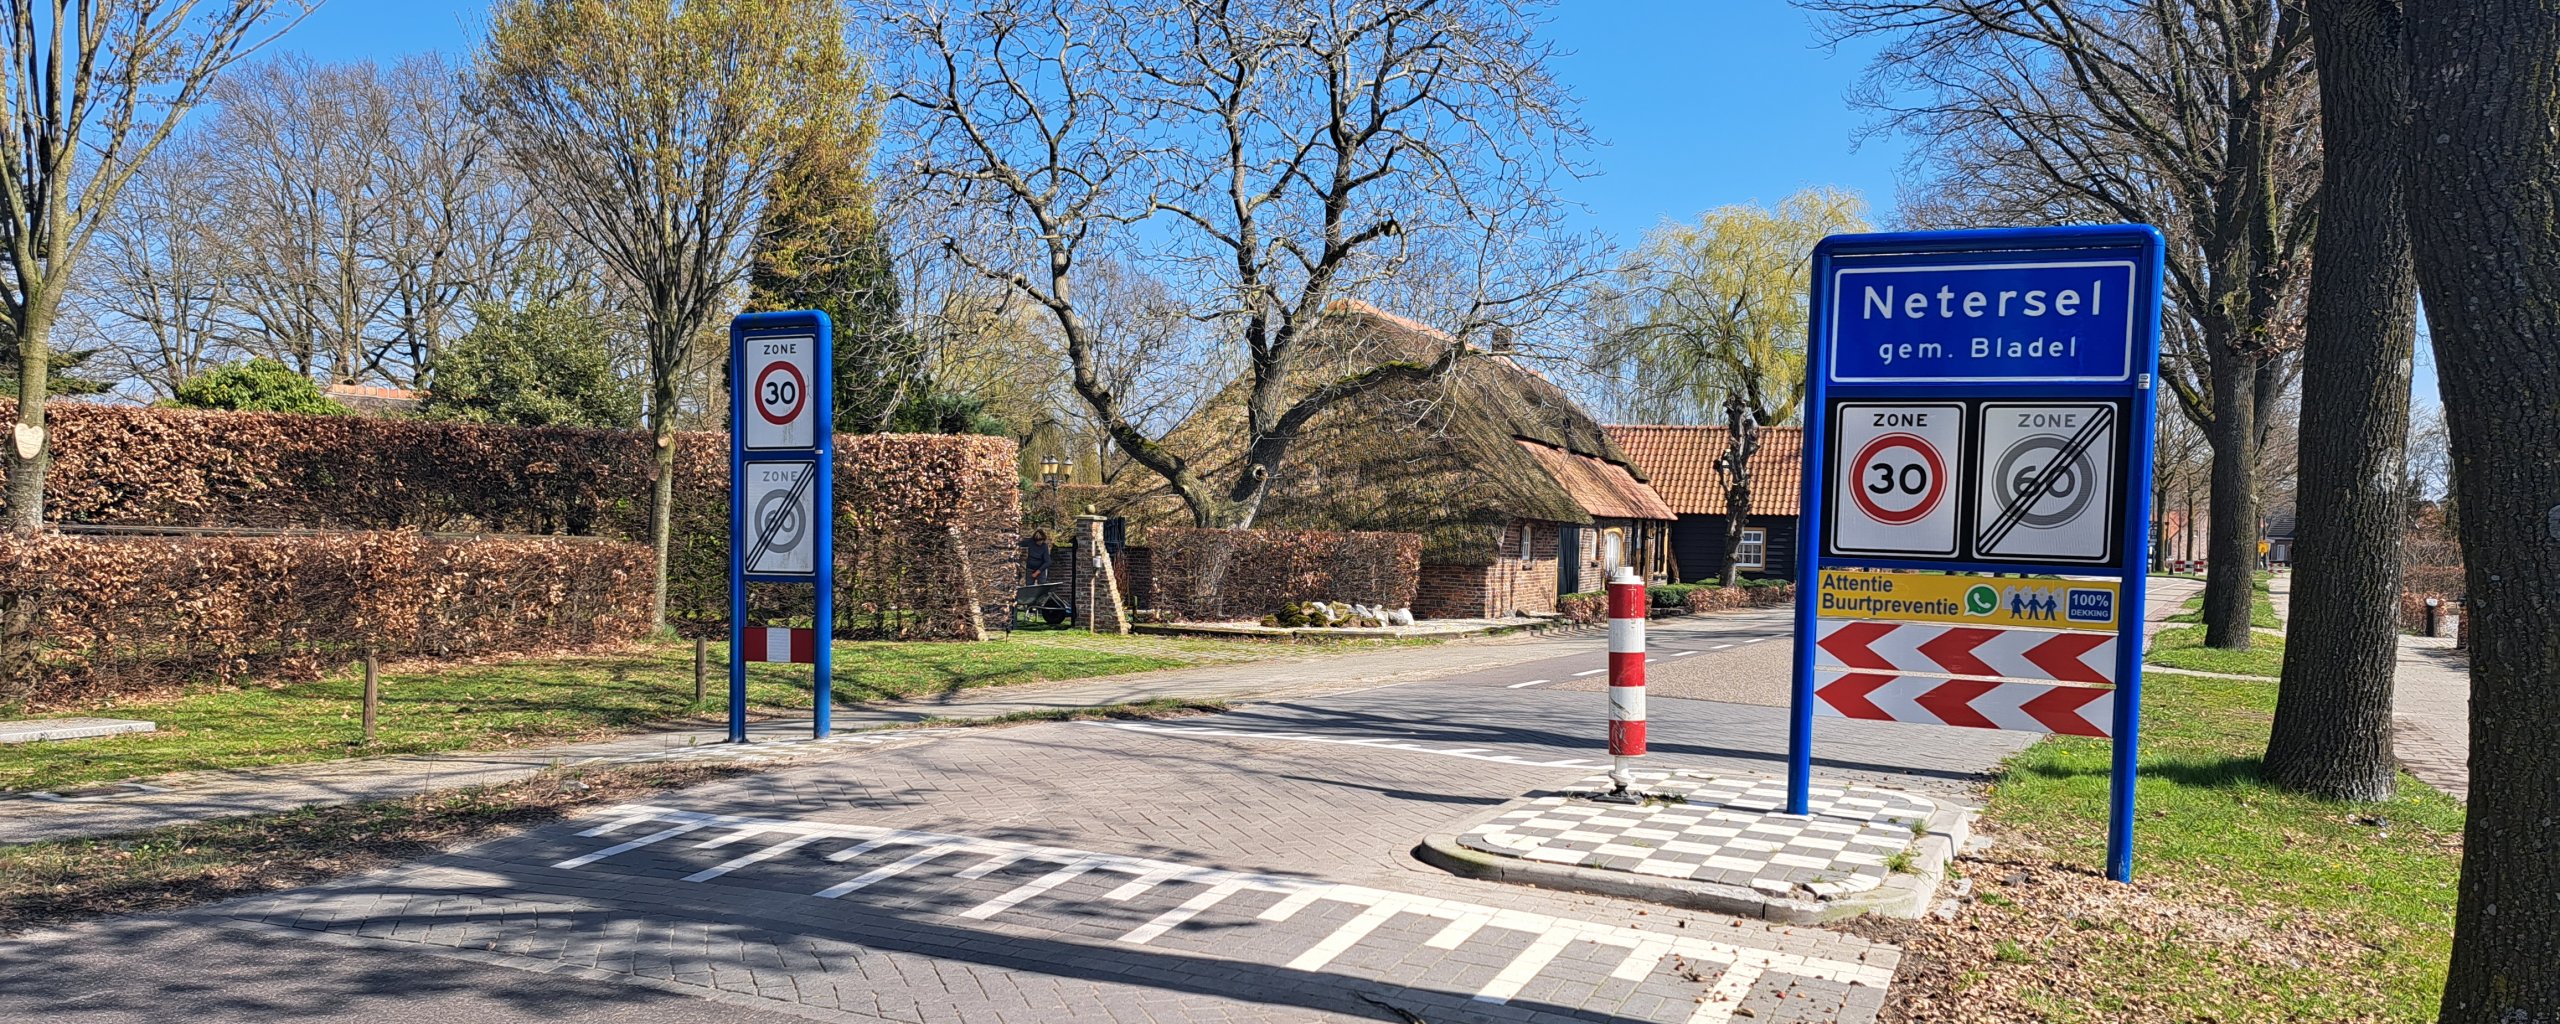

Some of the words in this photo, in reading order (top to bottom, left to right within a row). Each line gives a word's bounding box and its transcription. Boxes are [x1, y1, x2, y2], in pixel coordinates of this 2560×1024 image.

[1863, 280, 2102, 319] Netersel
[763, 343, 797, 355] ZONE
[1878, 341, 1954, 365] gem.
[1971, 336, 2076, 358] Bladel
[765, 381, 796, 405] 30
[1873, 413, 1928, 427] ZONE
[2017, 414, 2077, 428] ZONE
[763, 471, 799, 482] ZONE
[1868, 463, 1927, 495] 30
[2012, 465, 2076, 498] 60
[1822, 573, 1893, 593] Attentie
[1822, 594, 1959, 616] Buurtpreventie
[2072, 594, 2109, 607] 100%
[2070, 609, 2109, 617] DEKKING
